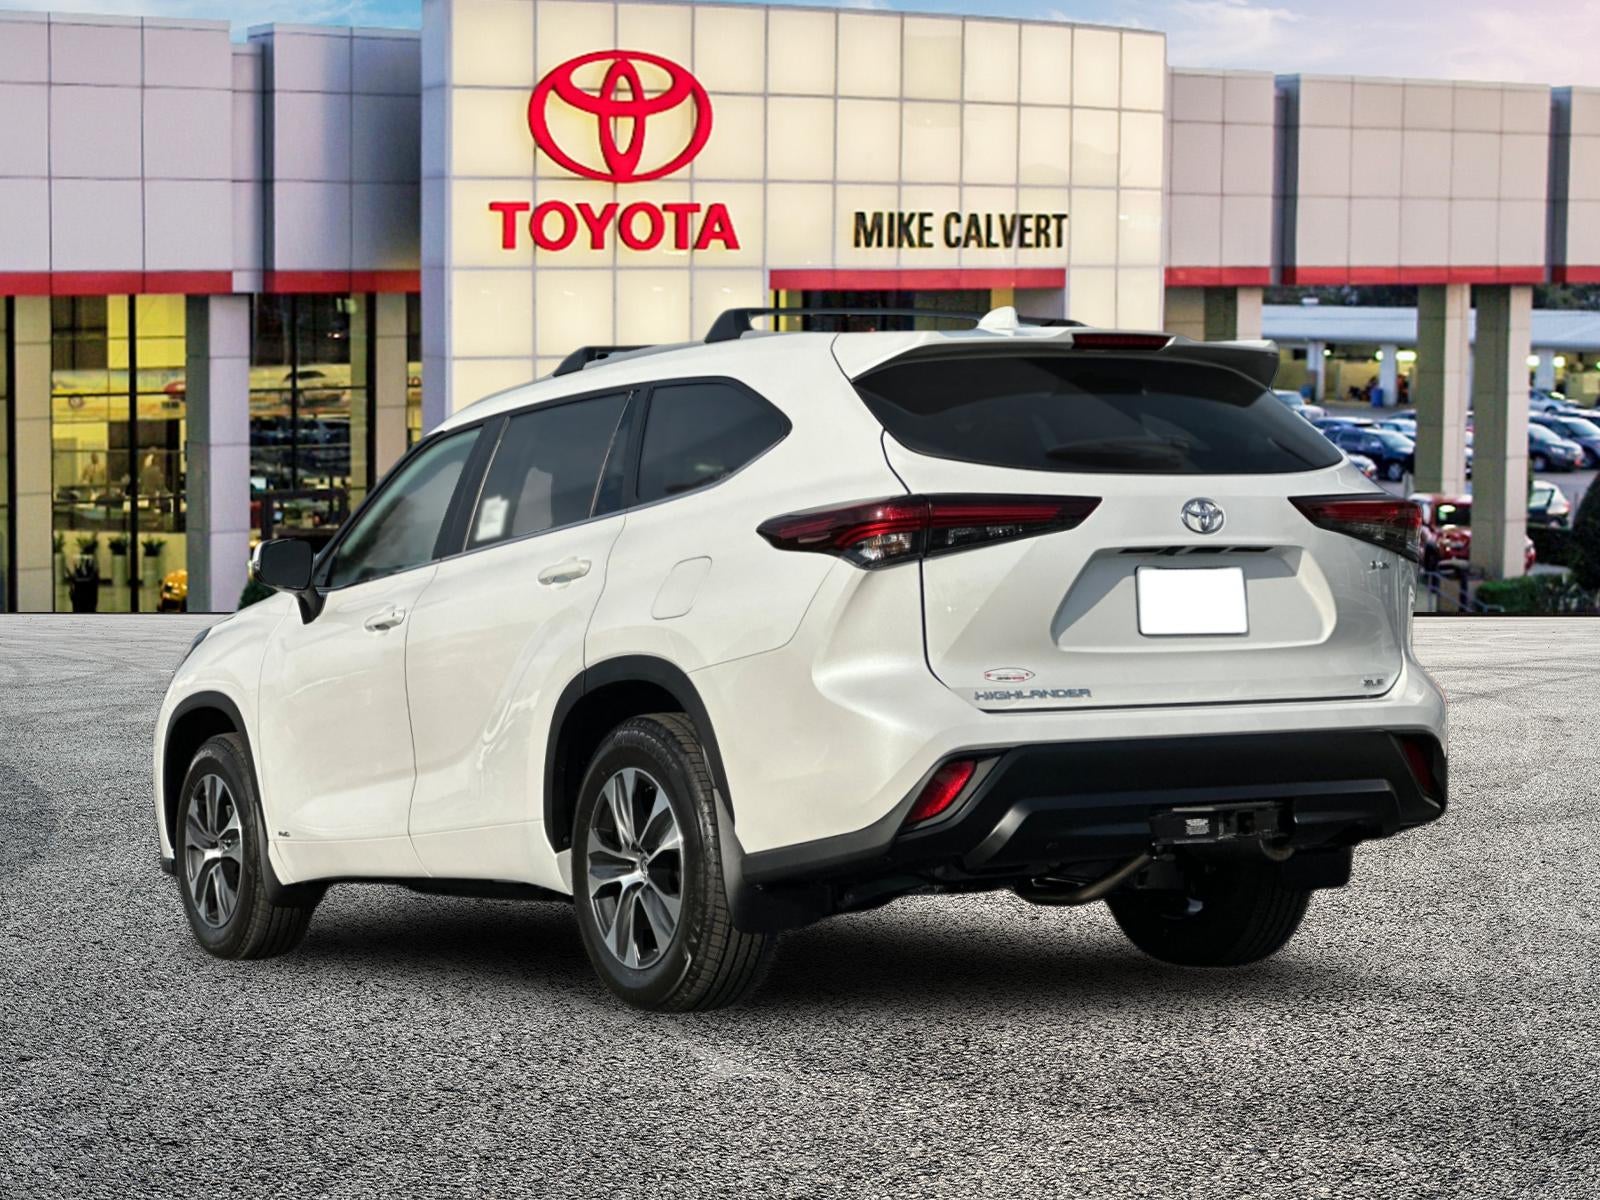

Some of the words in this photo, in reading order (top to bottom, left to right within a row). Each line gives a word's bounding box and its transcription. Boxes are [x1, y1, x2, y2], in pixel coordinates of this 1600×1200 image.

[488, 200, 741, 251] TOYOTA
[853, 211, 934, 248] MIKE
[943, 211, 1069, 248] CALVERT
[974, 688, 1092, 701] HIGHLANDER
